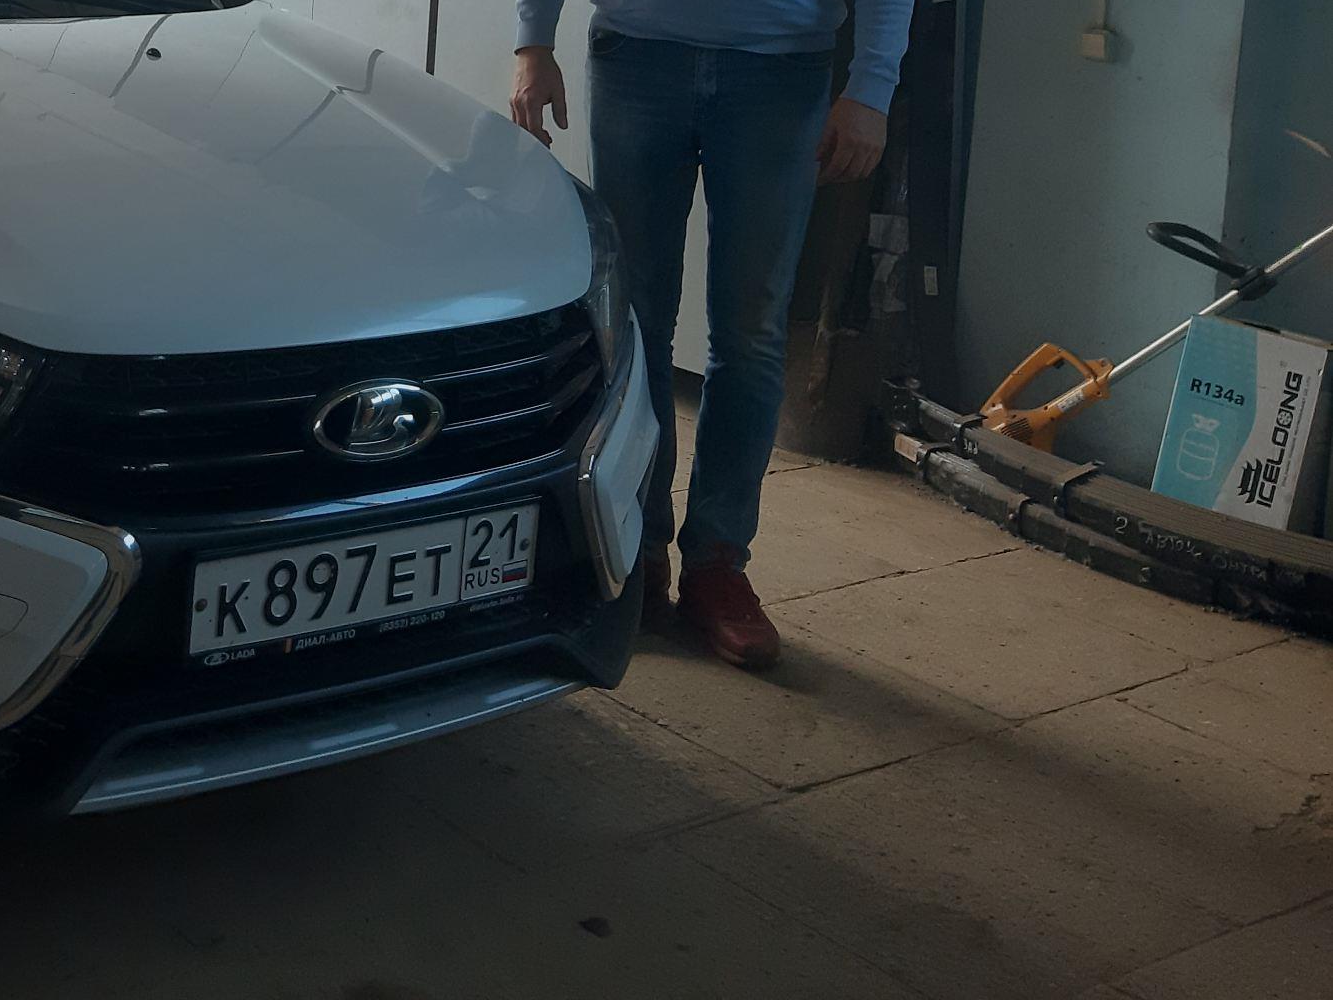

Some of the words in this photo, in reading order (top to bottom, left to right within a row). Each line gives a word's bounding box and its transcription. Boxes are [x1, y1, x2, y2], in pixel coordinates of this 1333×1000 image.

[1190, 378, 1245, 407] R134a
[215, 542, 452, 638] К897ЕТ
[469, 511, 520, 569] 21
[464, 567, 501, 591] RUS
[230, 647, 256, 661] LADA
[294, 627, 357, 652] ДИАЛ-АВТО
